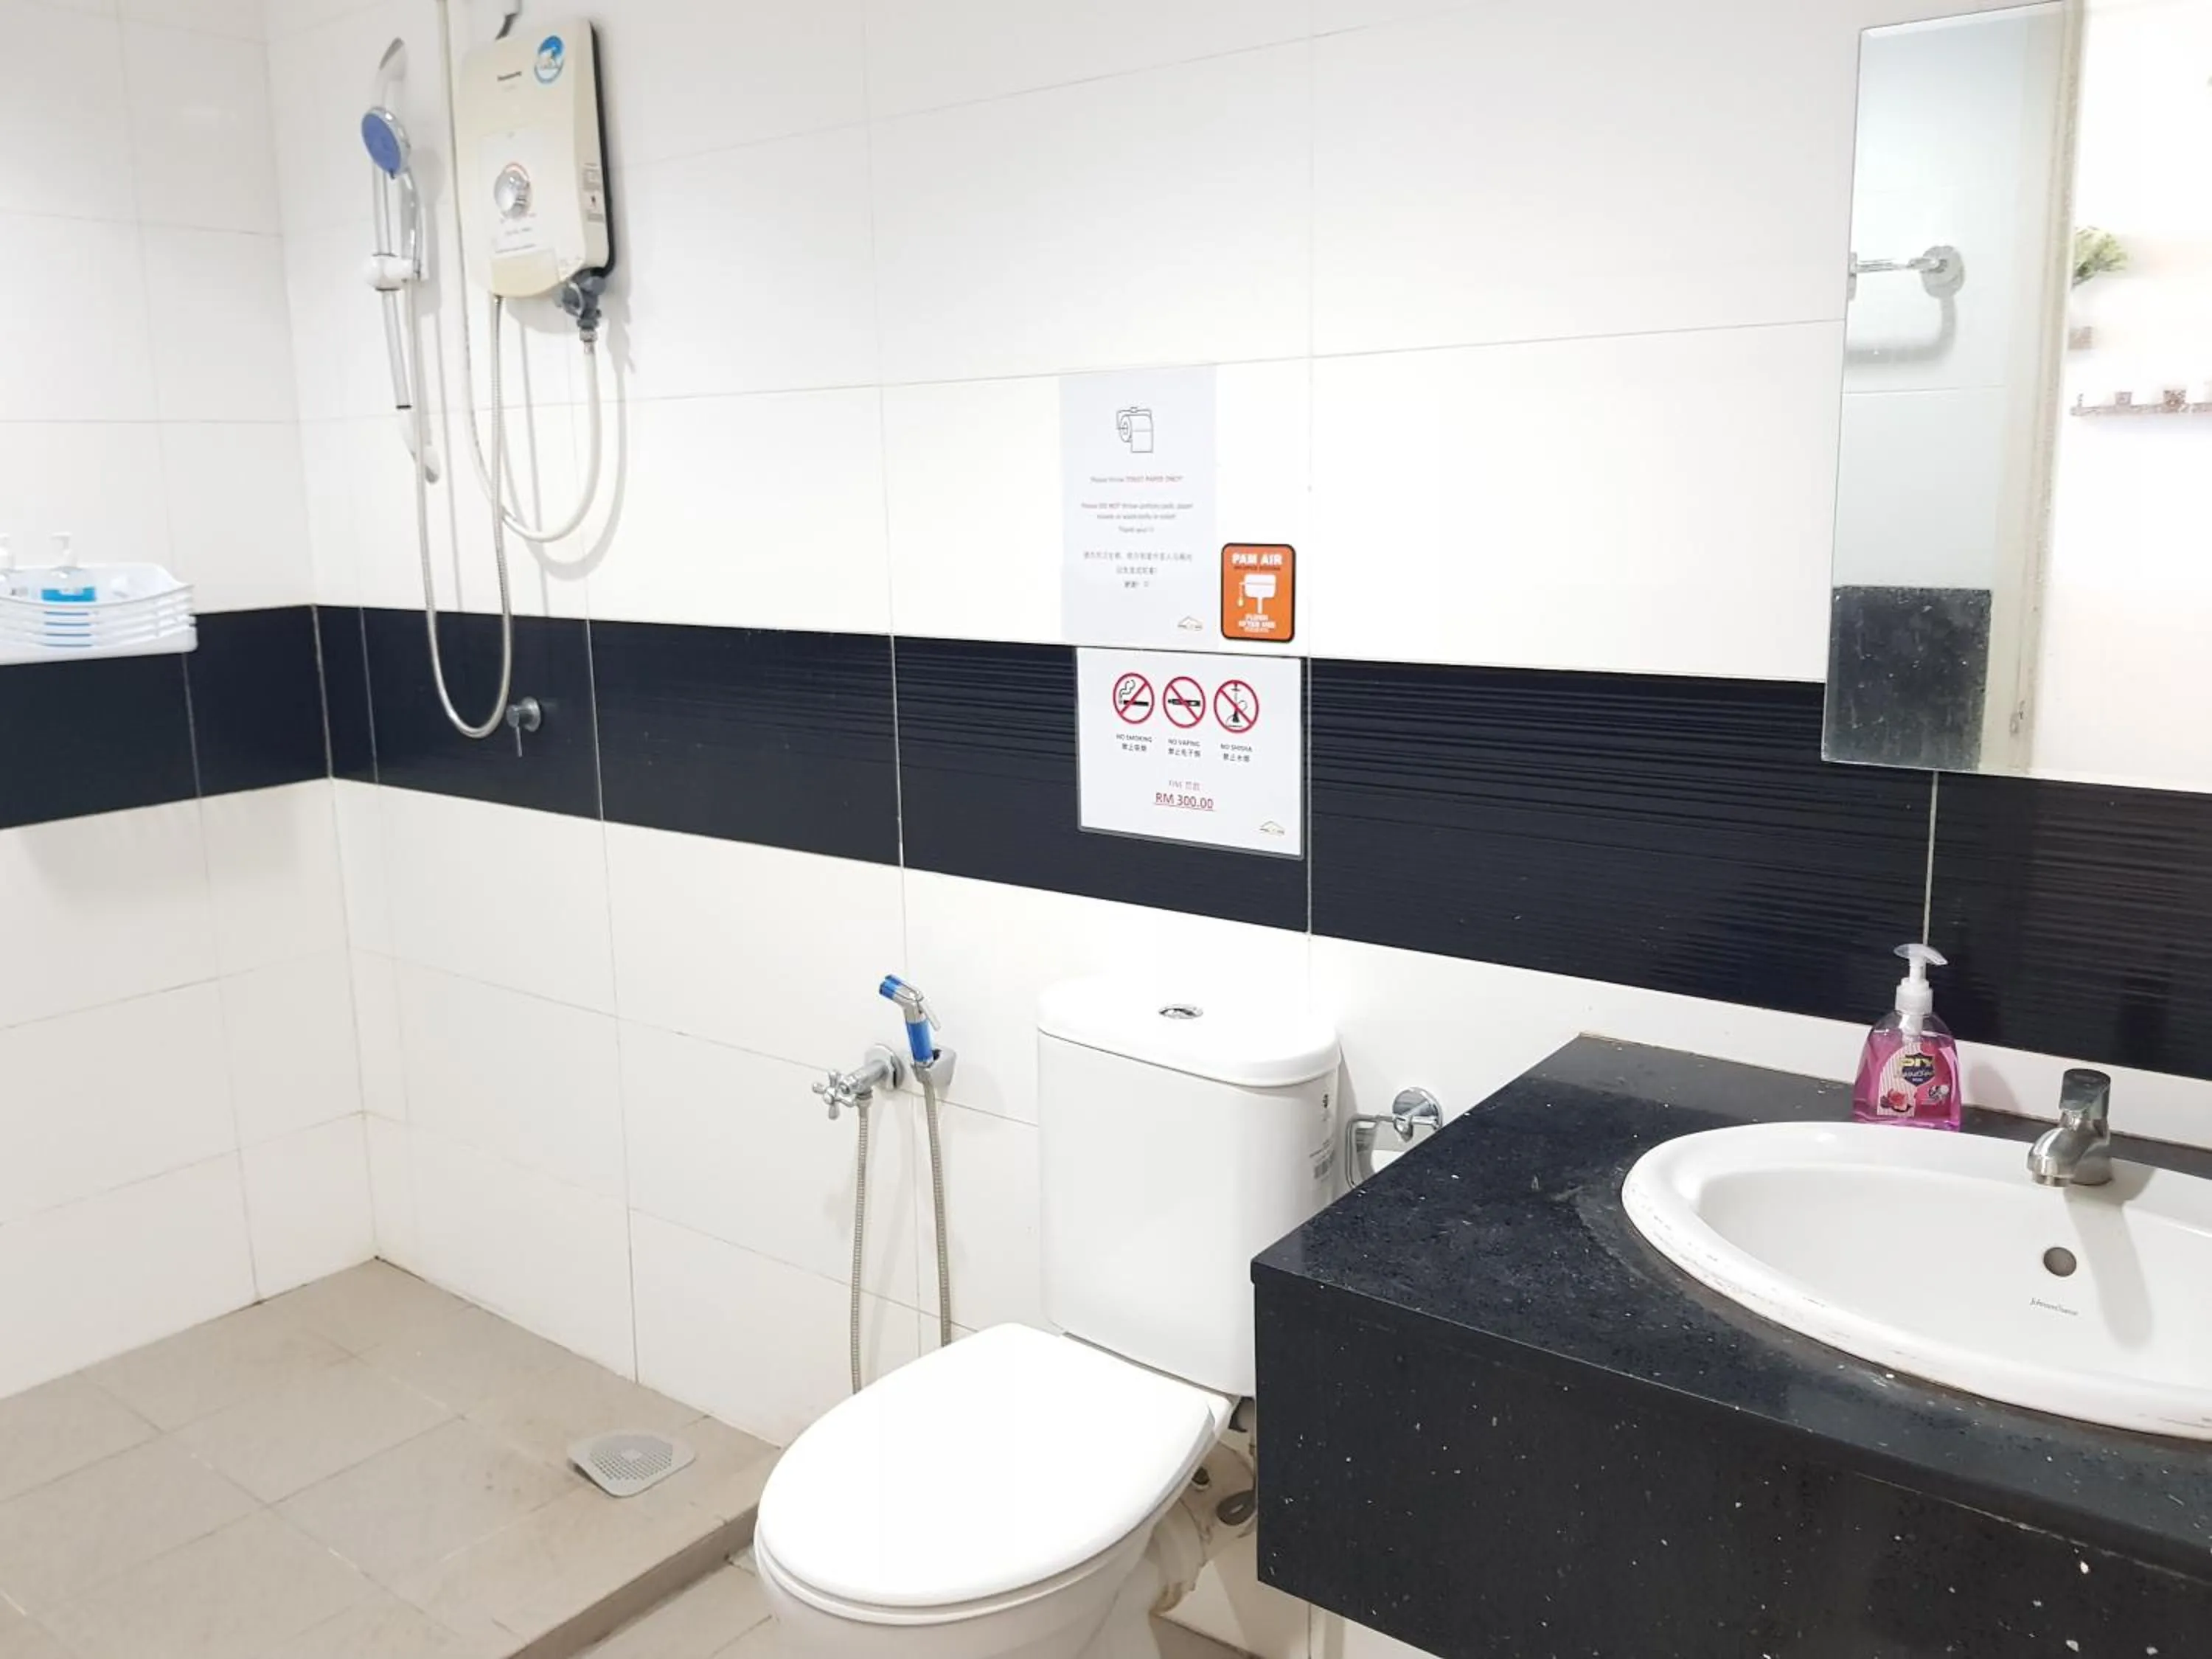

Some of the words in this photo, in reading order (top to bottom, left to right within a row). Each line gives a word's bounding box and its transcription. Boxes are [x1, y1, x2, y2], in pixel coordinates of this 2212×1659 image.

[1260, 554, 1283, 566] AIR
[1125, 734, 1152, 742] SMOKING
[1155, 792, 1174, 804] RM
[1176, 794, 1214, 809] 300.00
